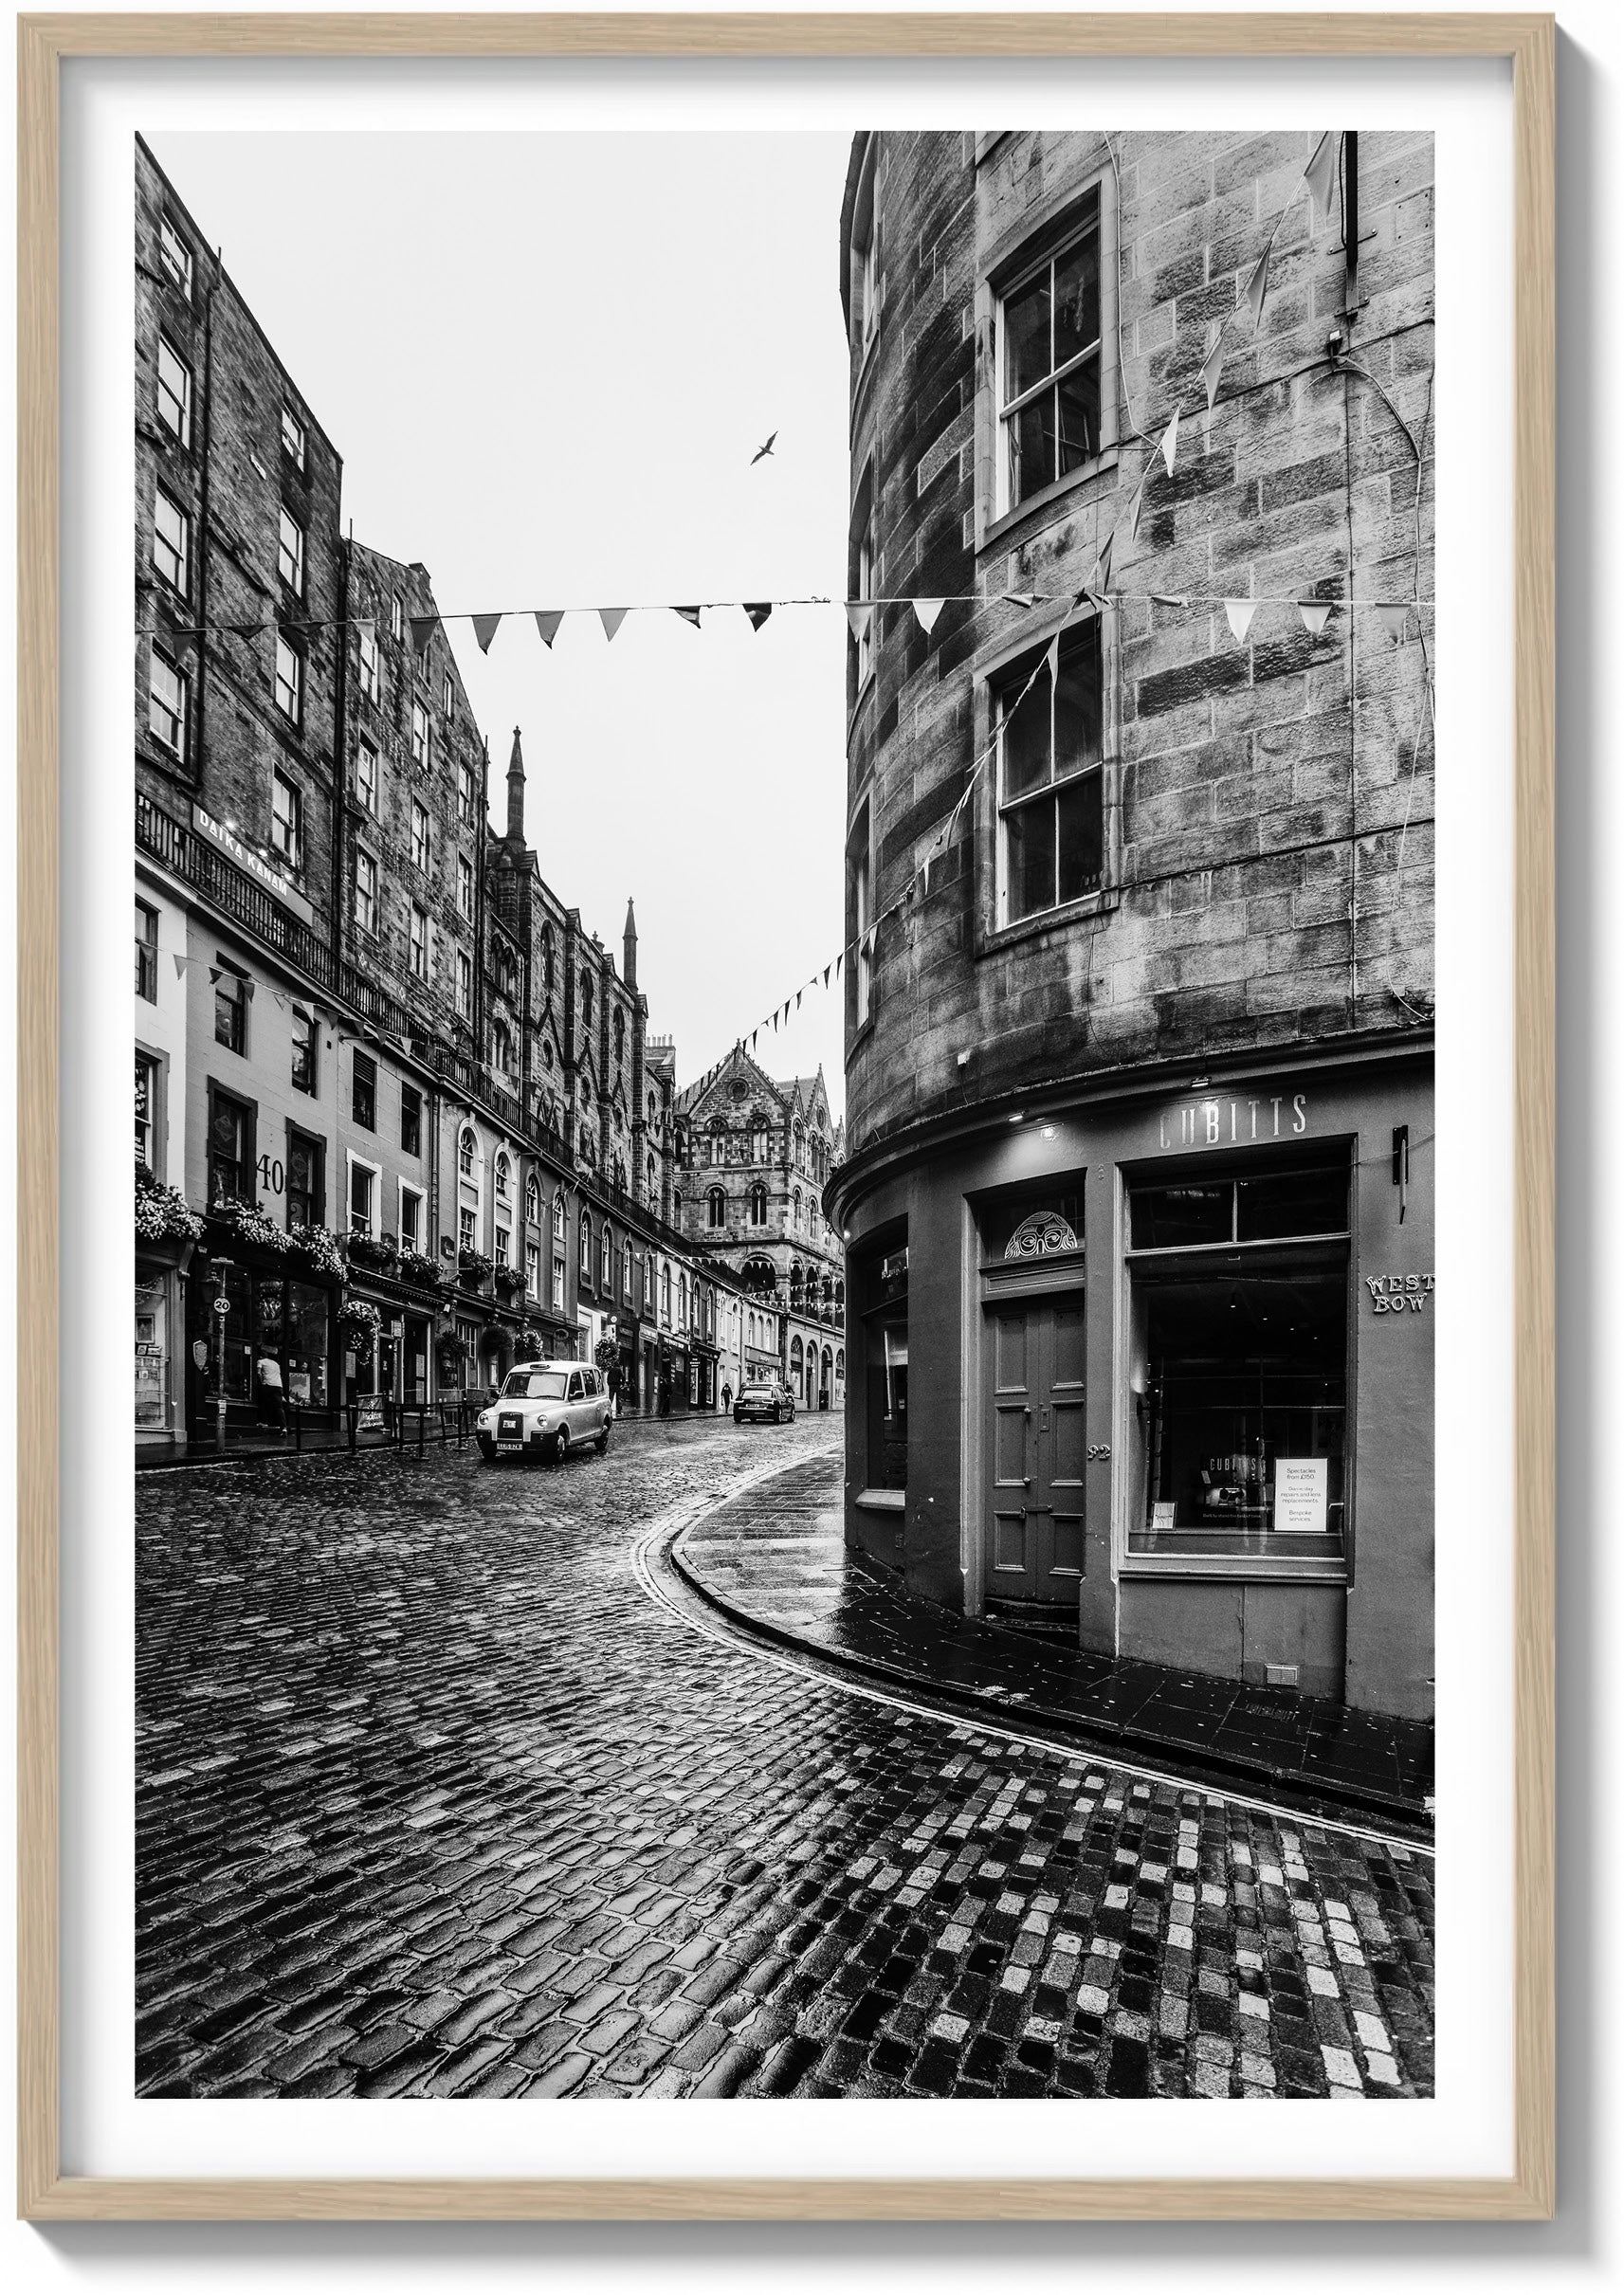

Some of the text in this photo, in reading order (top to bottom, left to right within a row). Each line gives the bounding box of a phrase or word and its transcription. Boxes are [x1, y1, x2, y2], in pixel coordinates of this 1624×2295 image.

[199, 810, 287, 896] DAIKA KANAM
[1159, 1094, 1306, 1149] CUBITTS
[257, 1154, 283, 1194] 40
[1365, 1273, 1434, 1296] WEST
[215, 1300, 229, 1309] 20
[1373, 1292, 1428, 1313] BOW
[1087, 1444, 1110, 1460] 92
